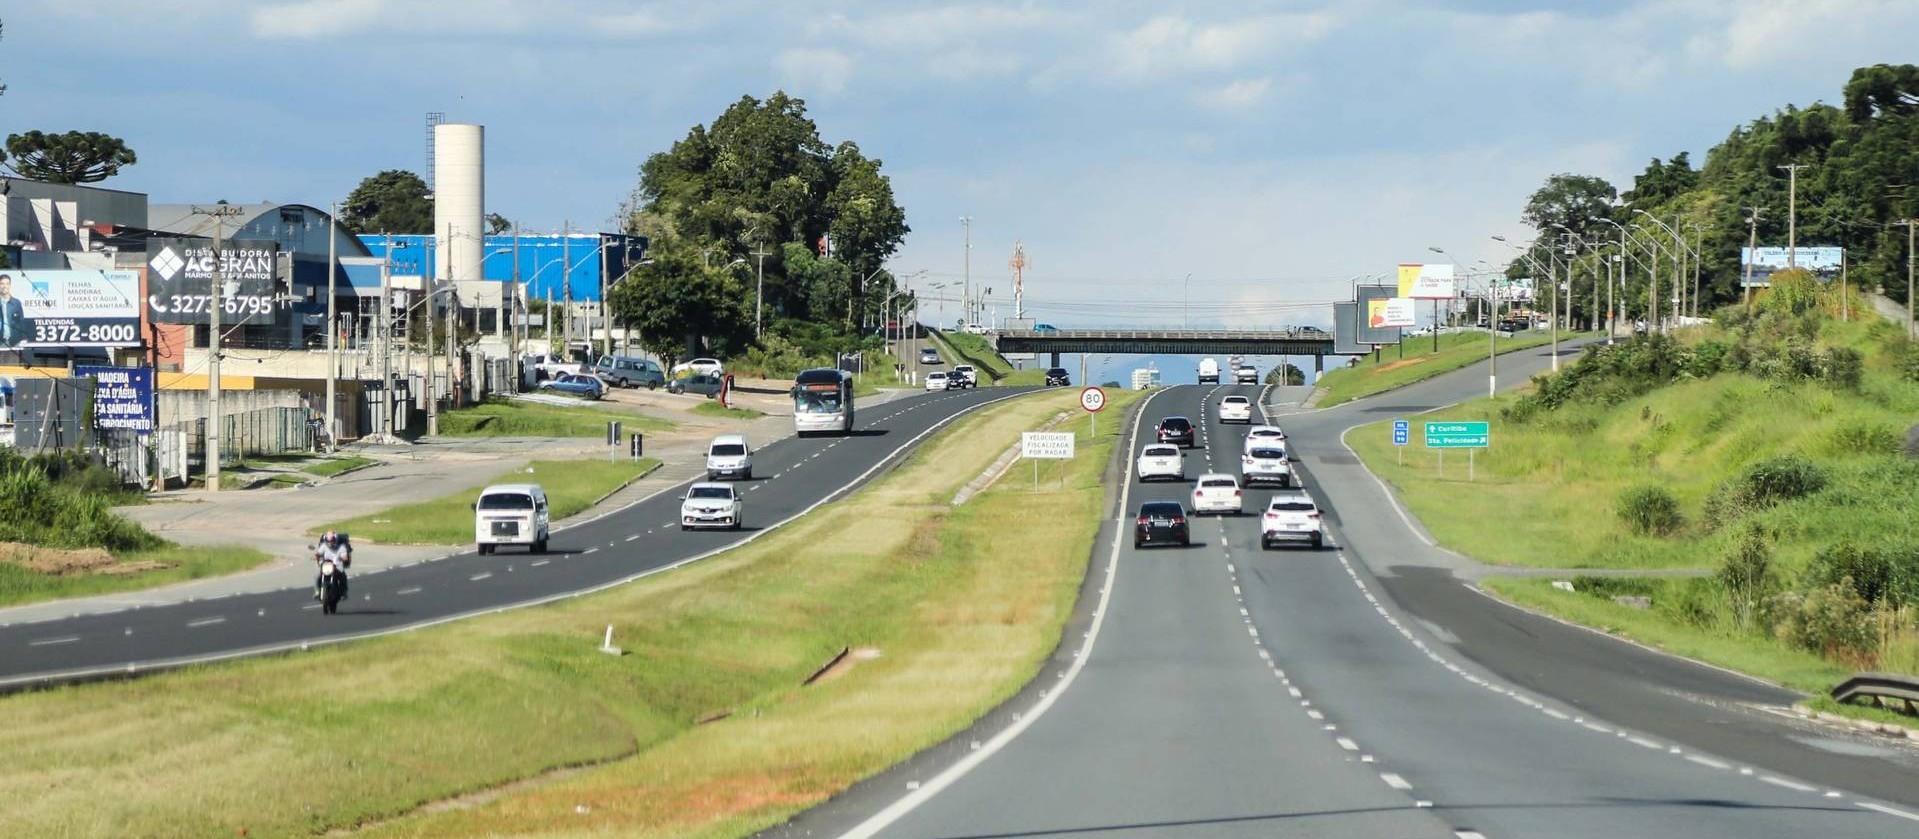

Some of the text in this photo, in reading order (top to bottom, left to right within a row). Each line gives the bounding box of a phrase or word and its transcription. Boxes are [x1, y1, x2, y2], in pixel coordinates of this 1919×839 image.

[185, 248, 270, 257] DISTBUIDORA
[185, 271, 225, 279] MÁRMOS
[35, 325, 135, 341] 3372-8000
[97, 372, 129, 383] MADEIRA
[1086, 394, 1100, 404] 80
[106, 402, 143, 414] SANITÁRIA
